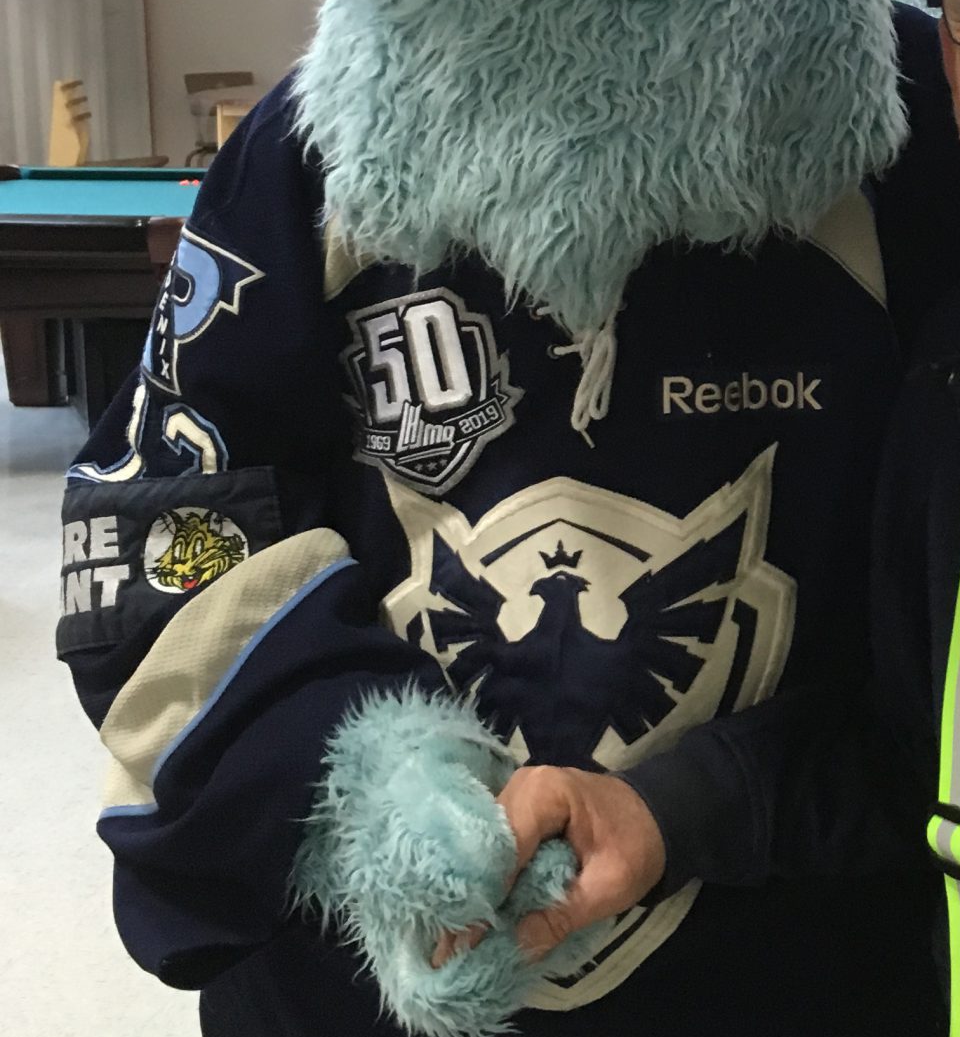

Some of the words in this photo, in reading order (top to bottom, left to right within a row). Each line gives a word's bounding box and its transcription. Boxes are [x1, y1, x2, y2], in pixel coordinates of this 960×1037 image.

[364, 298, 473, 424] 50
[663, 372, 823, 414] Reebok
[366, 434, 391, 451] 1969
[458, 404, 499, 434] 2019
